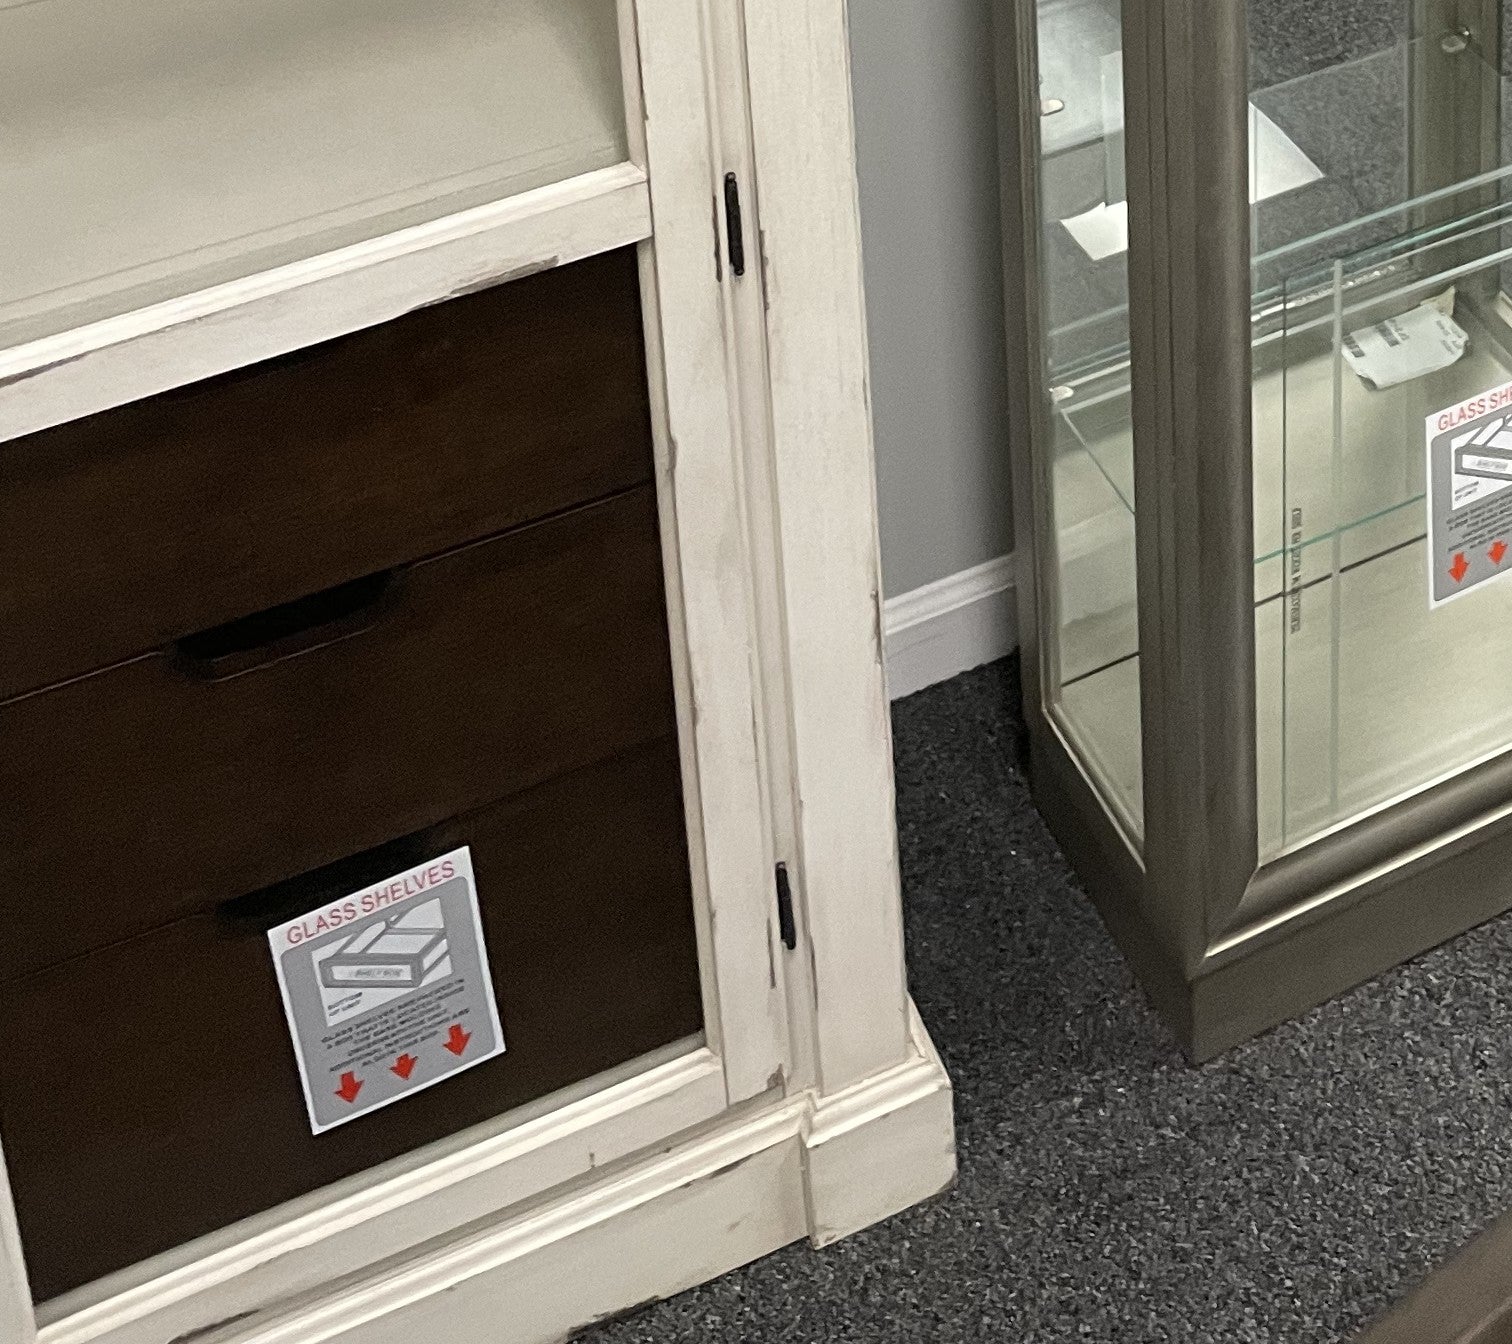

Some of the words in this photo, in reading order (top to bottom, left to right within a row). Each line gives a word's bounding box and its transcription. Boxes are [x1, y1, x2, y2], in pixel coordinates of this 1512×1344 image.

[1437, 398, 1486, 432] GLASS
[286, 902, 355, 945] GLASS
[361, 860, 455, 913] SHELVES
